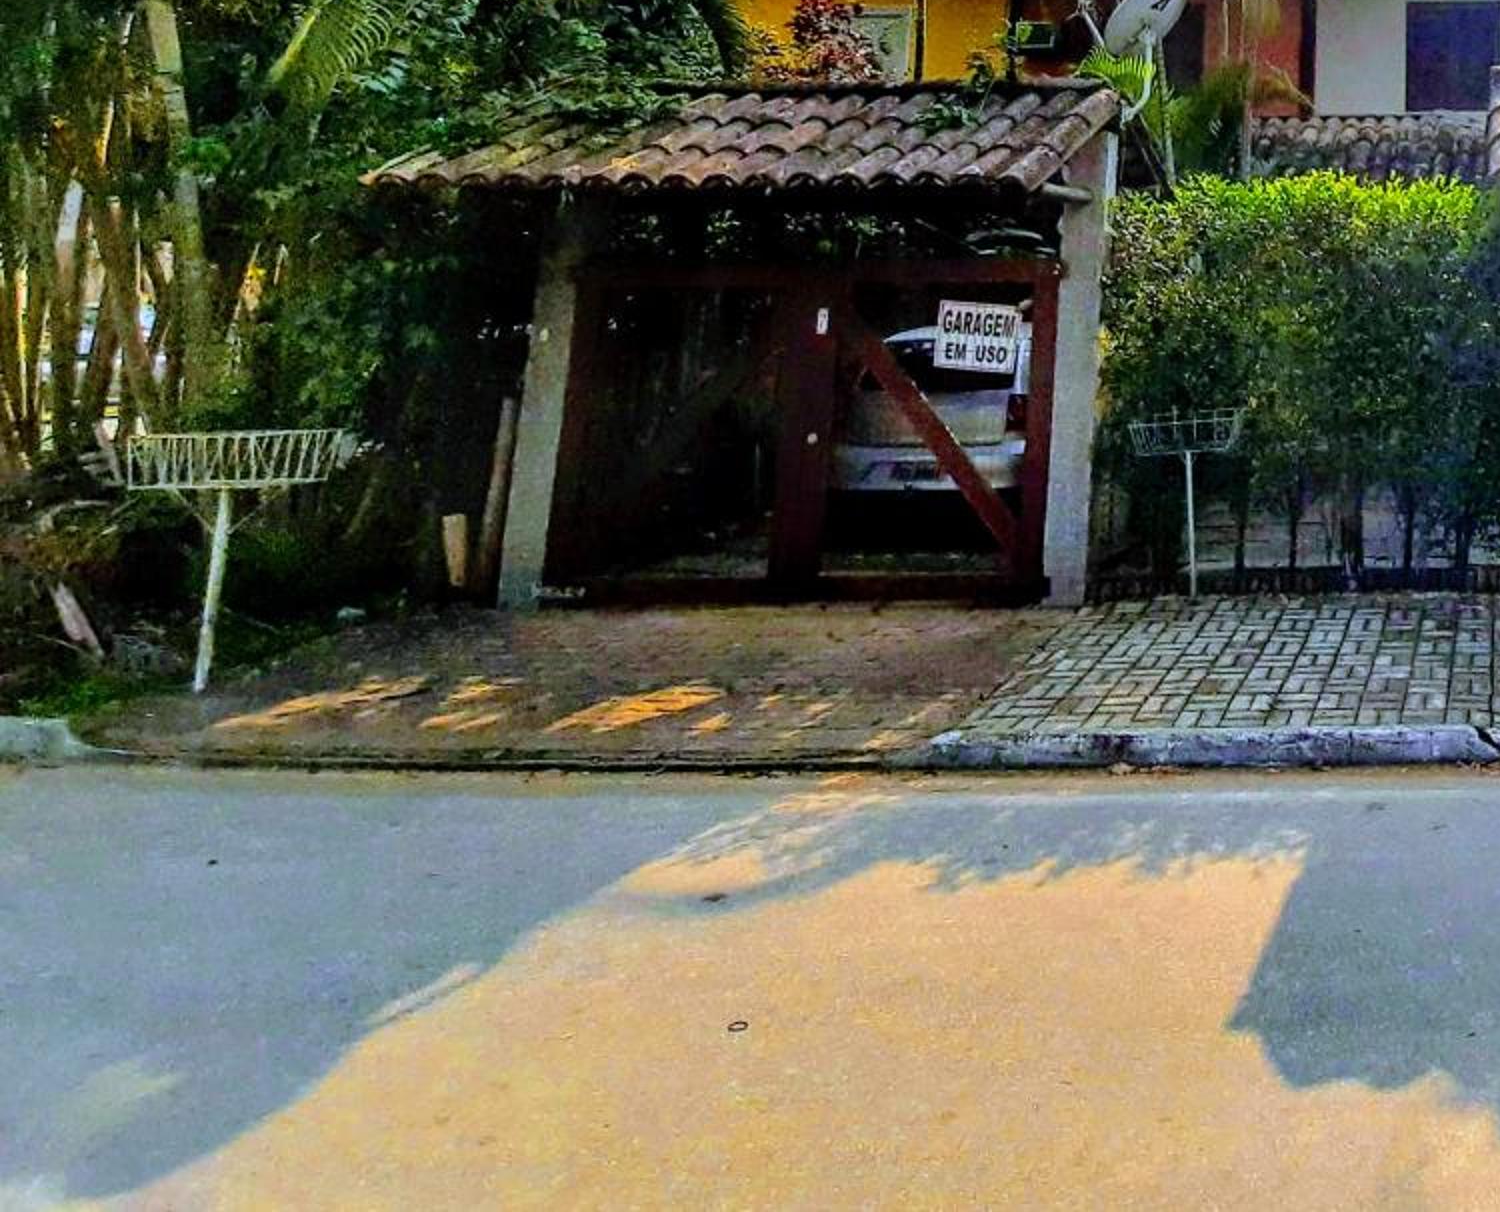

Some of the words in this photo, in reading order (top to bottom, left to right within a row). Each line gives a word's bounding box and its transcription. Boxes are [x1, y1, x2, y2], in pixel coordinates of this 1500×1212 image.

[943, 310, 1016, 338] GARAGEM
[945, 342, 967, 360] EM
[976, 345, 1008, 364] USO
